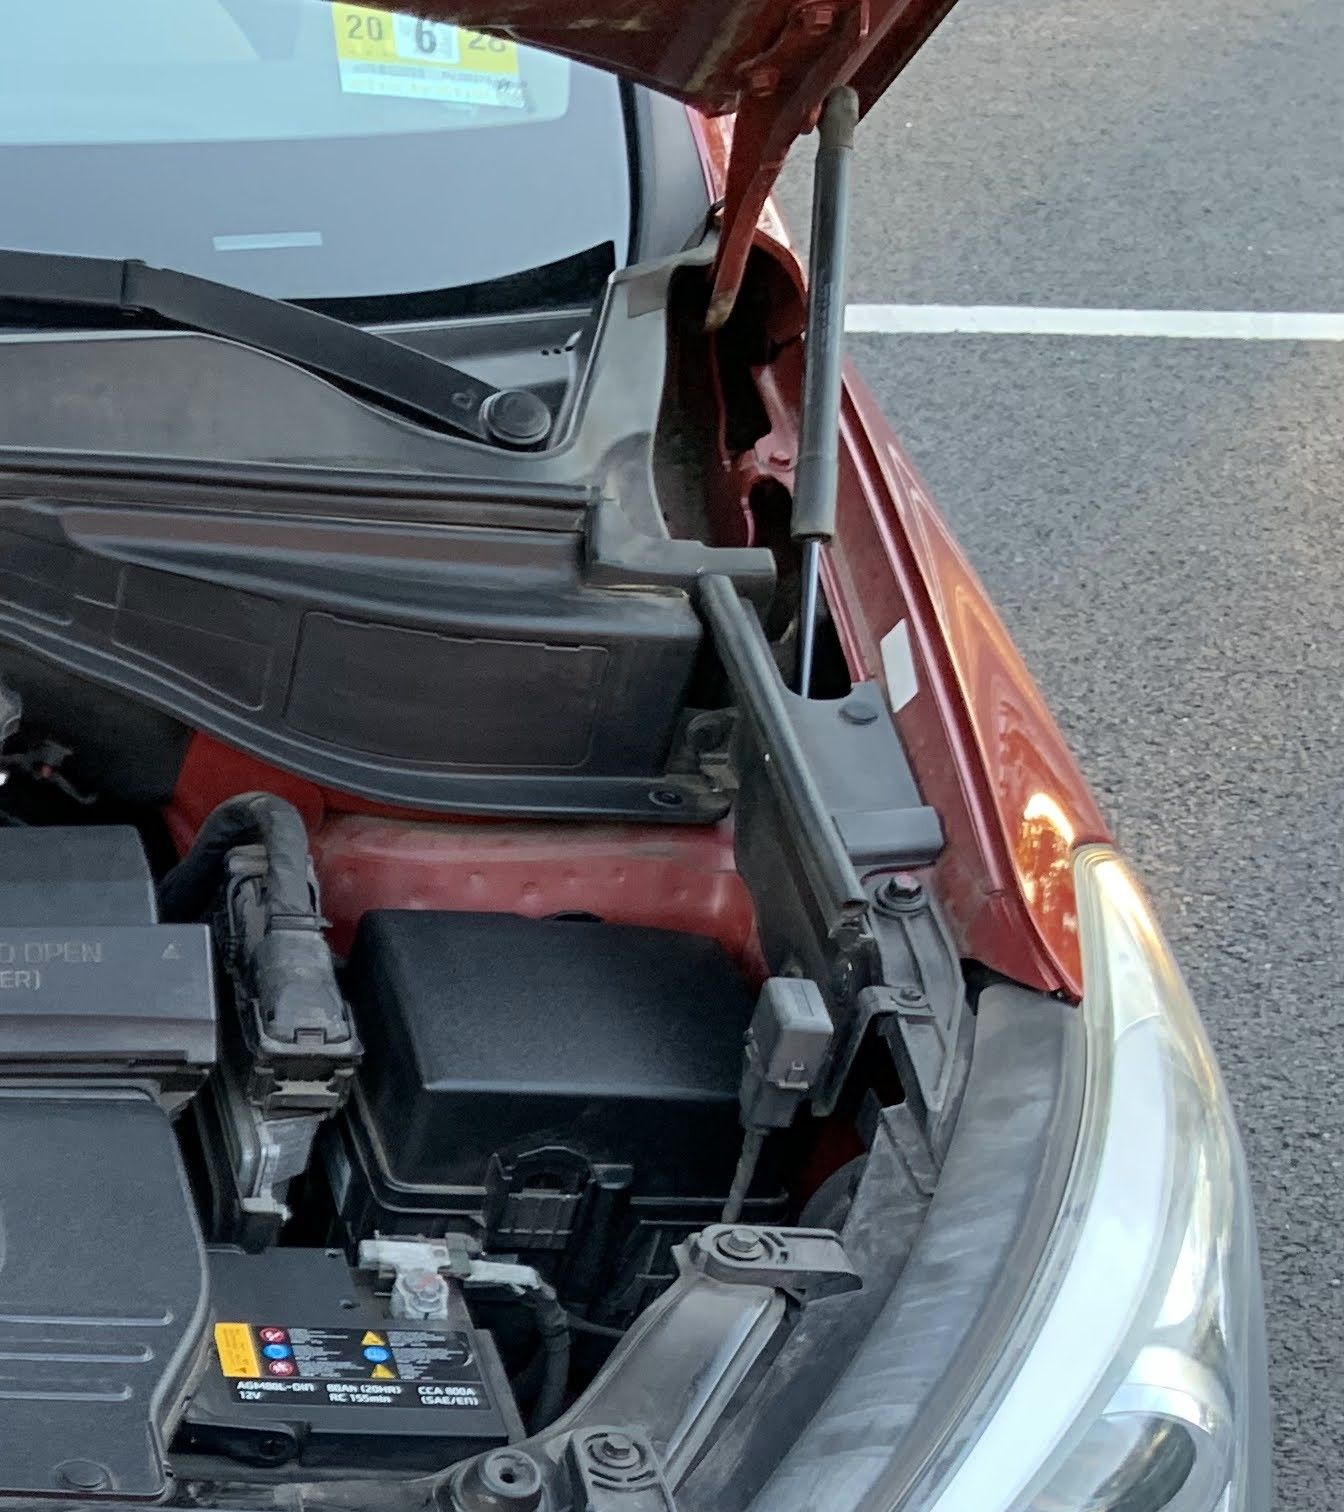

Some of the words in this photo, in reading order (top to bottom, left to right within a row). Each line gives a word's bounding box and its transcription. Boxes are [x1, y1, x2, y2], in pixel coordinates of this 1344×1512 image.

[345, 14, 384, 41] 20
[415, 19, 437, 54] 6
[24, 941, 104, 964] OPEN
[417, 1386, 443, 1396] CCA
